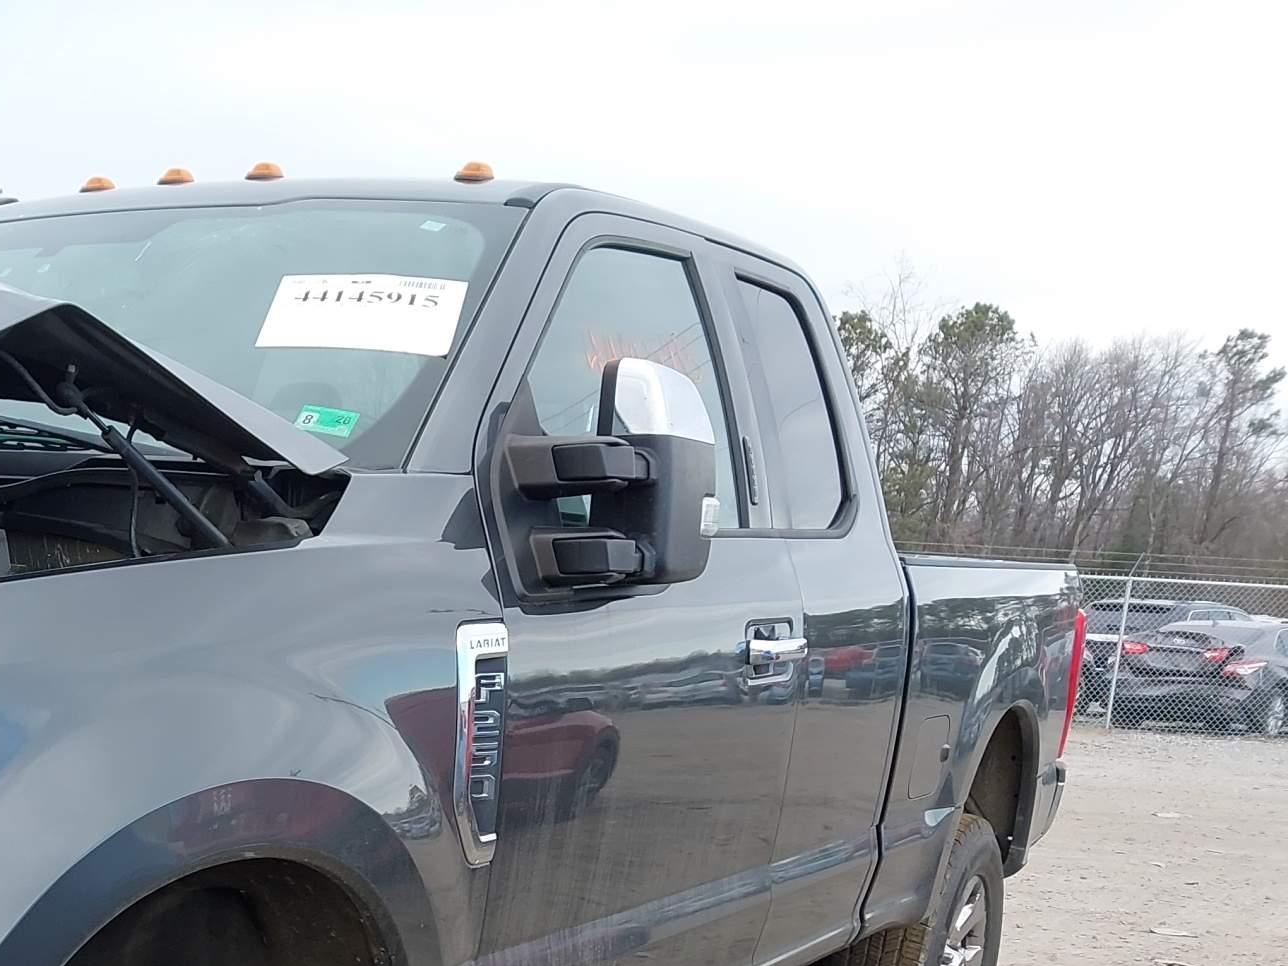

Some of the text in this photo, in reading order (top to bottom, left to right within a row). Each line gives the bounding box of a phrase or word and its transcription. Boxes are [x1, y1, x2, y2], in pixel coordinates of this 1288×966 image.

[294, 289, 441, 308] 44145915
[302, 414, 314, 425] 8
[469, 636, 507, 651] LARIAT
